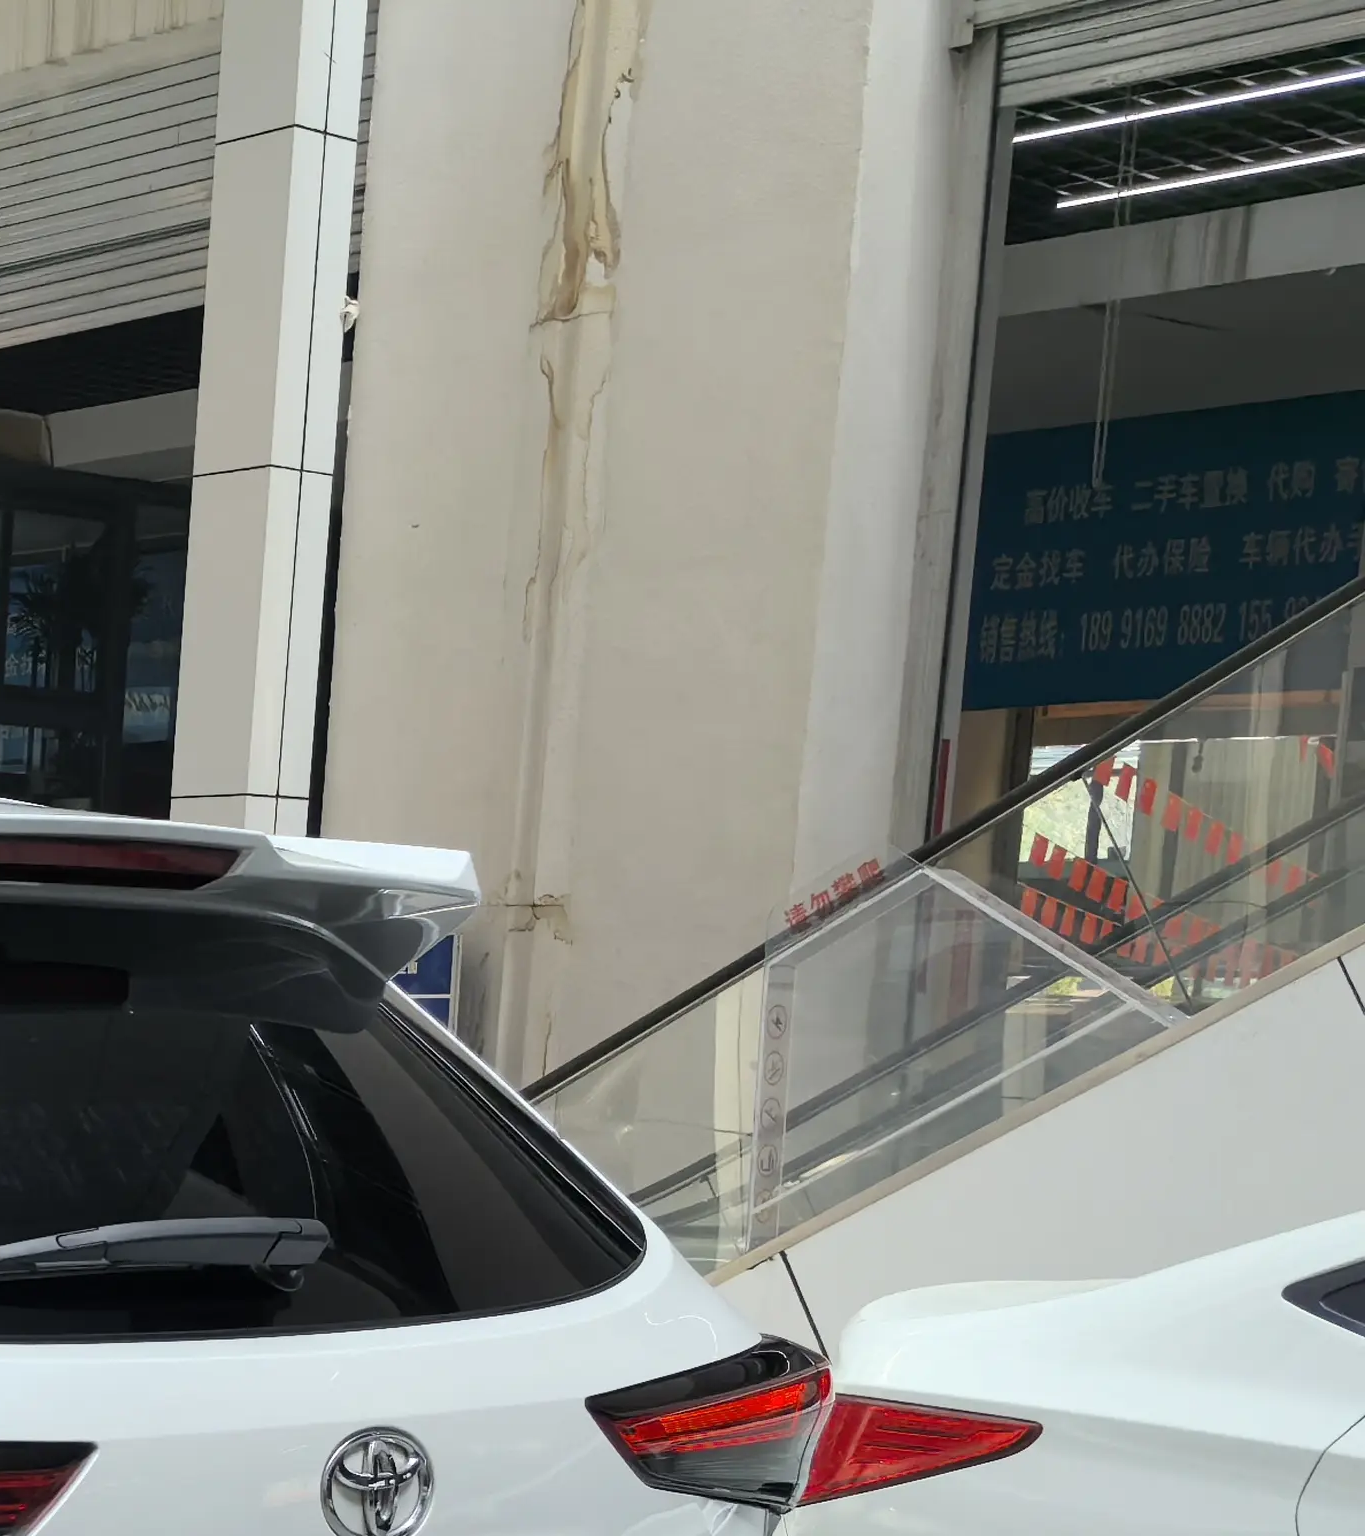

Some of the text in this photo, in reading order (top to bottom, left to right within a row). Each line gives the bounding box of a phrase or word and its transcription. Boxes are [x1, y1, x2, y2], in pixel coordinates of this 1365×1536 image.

[1025, 480, 1115, 526] 高价收车
[1113, 535, 1213, 580] 代办保险
[1080, 610, 1113, 653] 189
[1120, 605, 1168, 649] 9169
[1177, 602, 1226, 646] 8882
